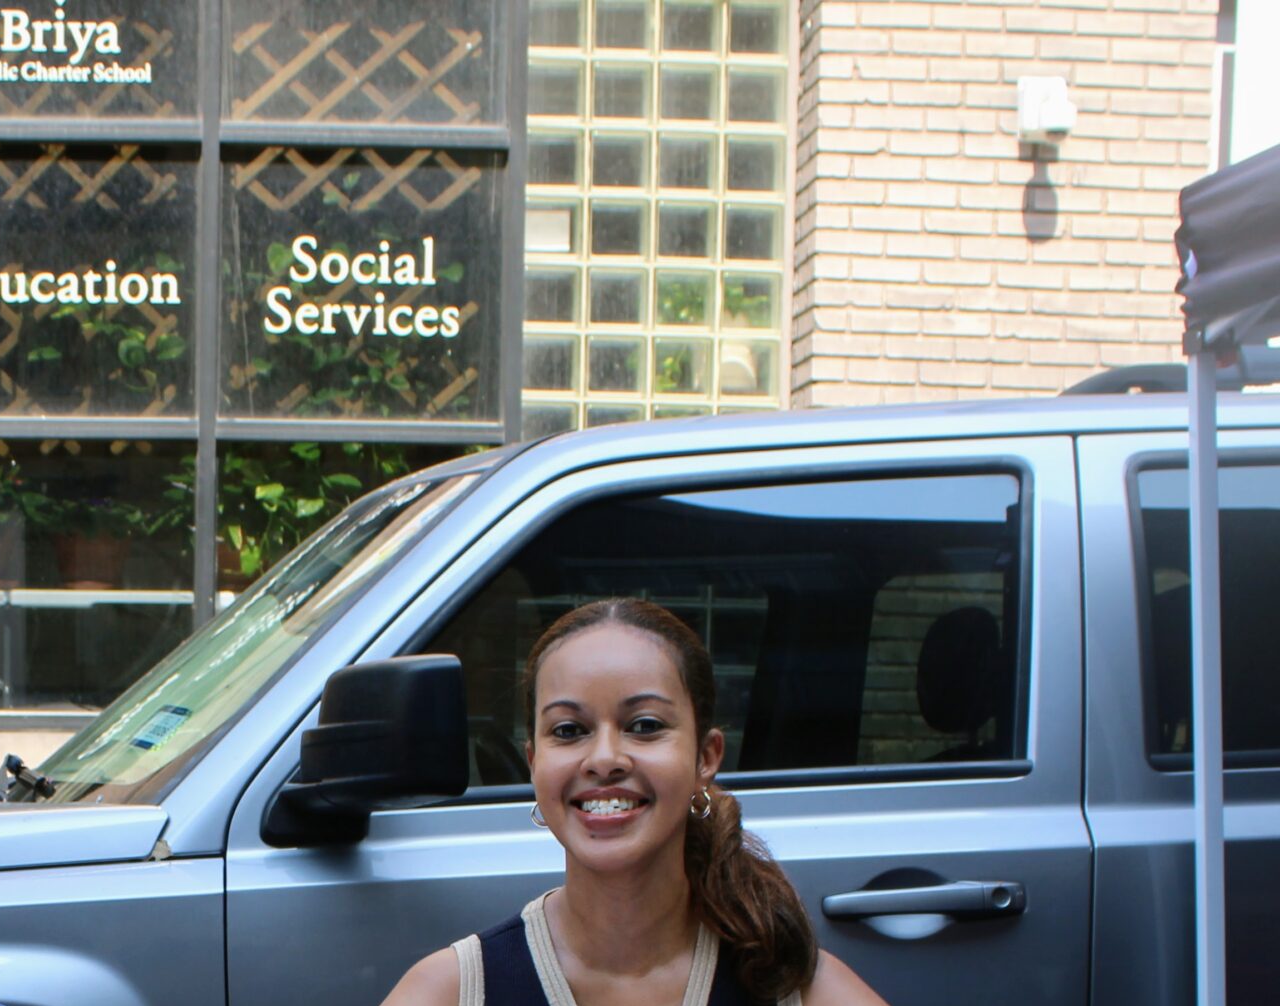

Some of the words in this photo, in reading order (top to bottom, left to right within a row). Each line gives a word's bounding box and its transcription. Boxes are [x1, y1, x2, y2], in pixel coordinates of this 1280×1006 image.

[0, 9, 121, 64] Briya
[20, 62, 91, 83] Charter
[93, 62, 152, 83] School
[289, 235, 437, 286] Social
[264, 286, 460, 338] Services
